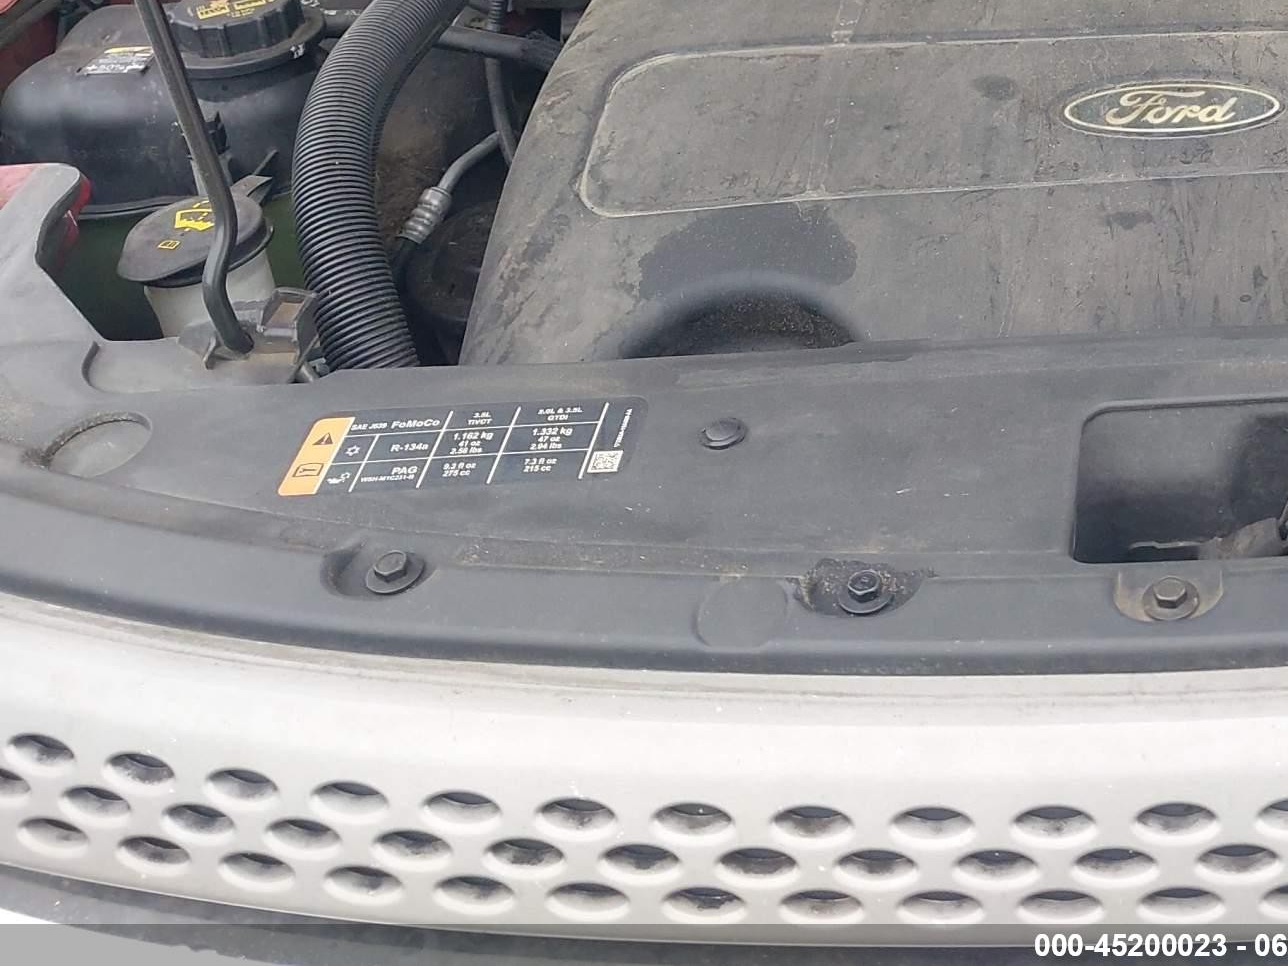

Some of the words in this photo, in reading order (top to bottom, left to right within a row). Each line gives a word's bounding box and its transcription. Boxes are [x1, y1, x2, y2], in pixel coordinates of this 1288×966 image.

[1105, 90, 1239, 125] Ford
[391, 419, 441, 429] FoMoCo
[390, 442, 430, 453] R-134a
[391, 465, 418, 475] PAG
